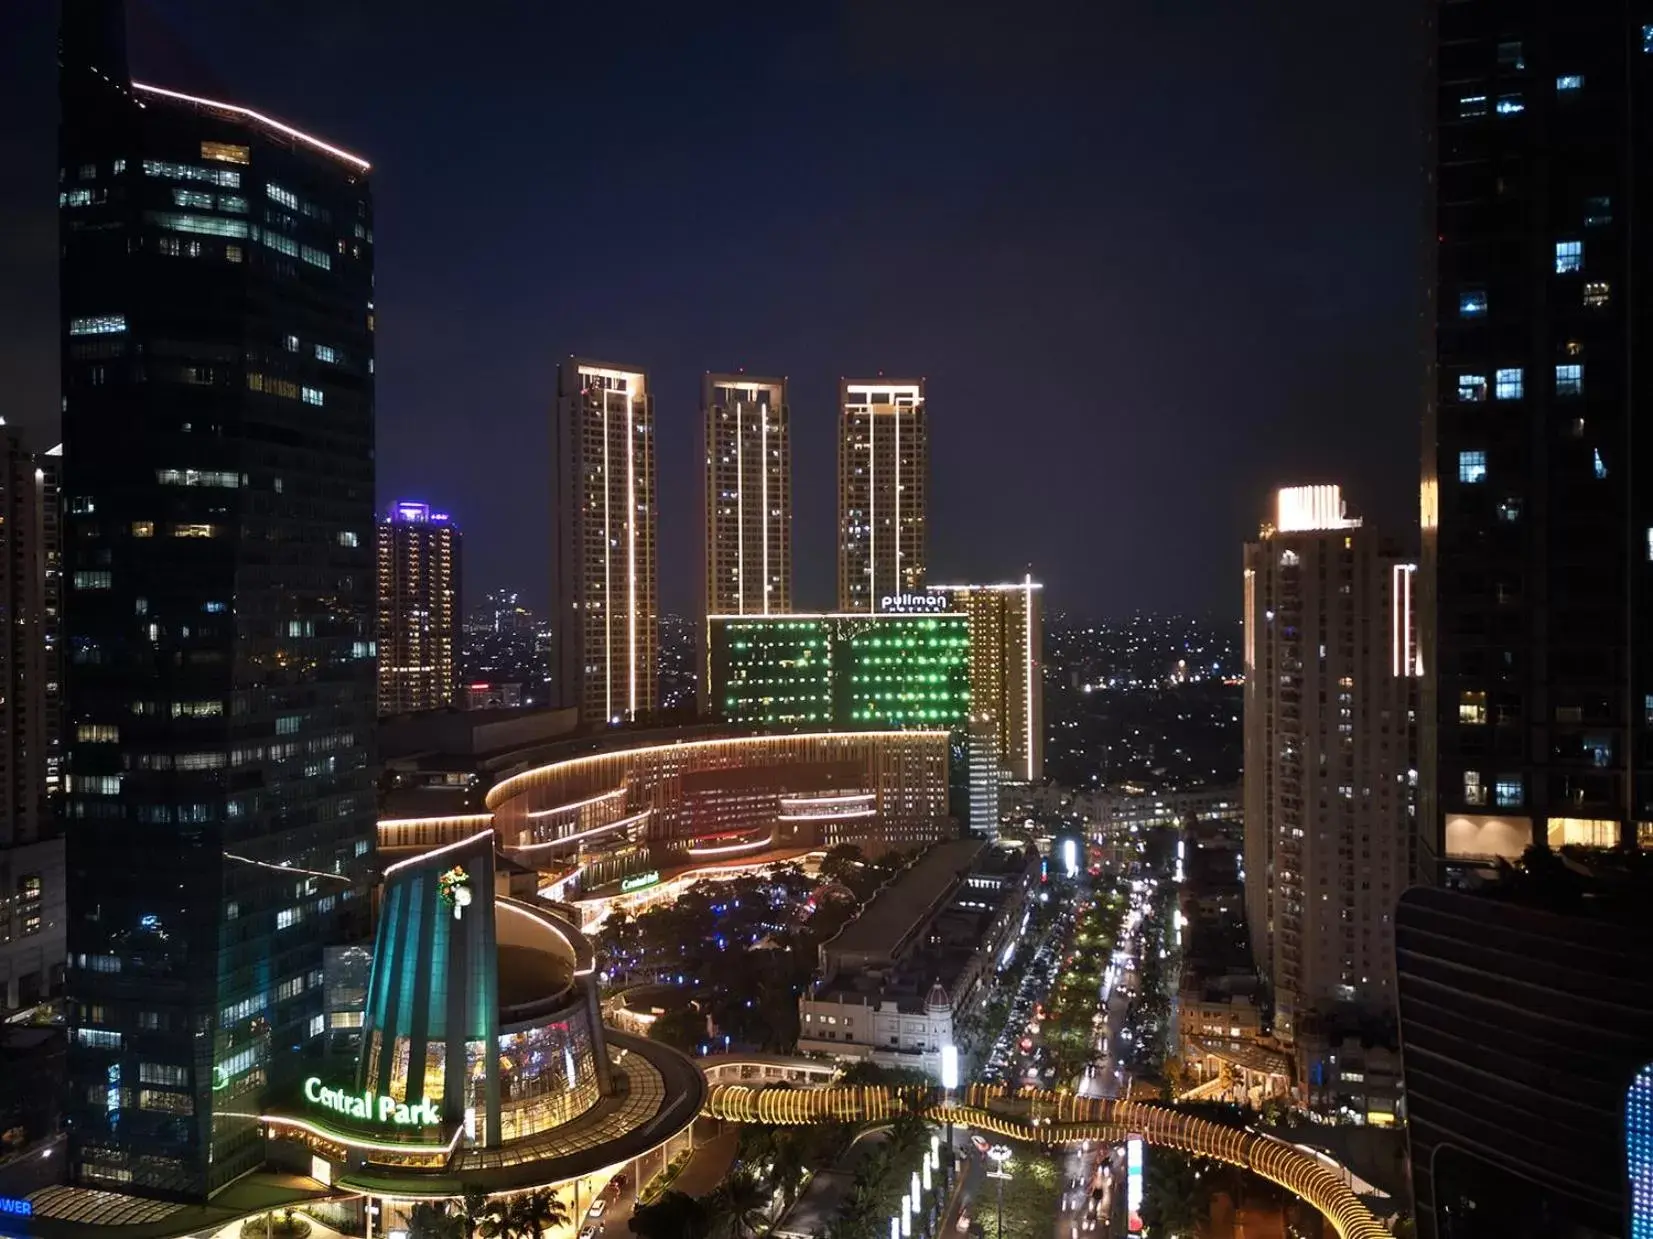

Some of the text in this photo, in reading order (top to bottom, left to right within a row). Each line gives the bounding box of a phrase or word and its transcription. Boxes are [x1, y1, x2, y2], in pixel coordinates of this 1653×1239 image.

[881, 594, 947, 609] pullman
[304, 1076, 441, 1124] Central Park
[0, 1198, 31, 1216] WER
